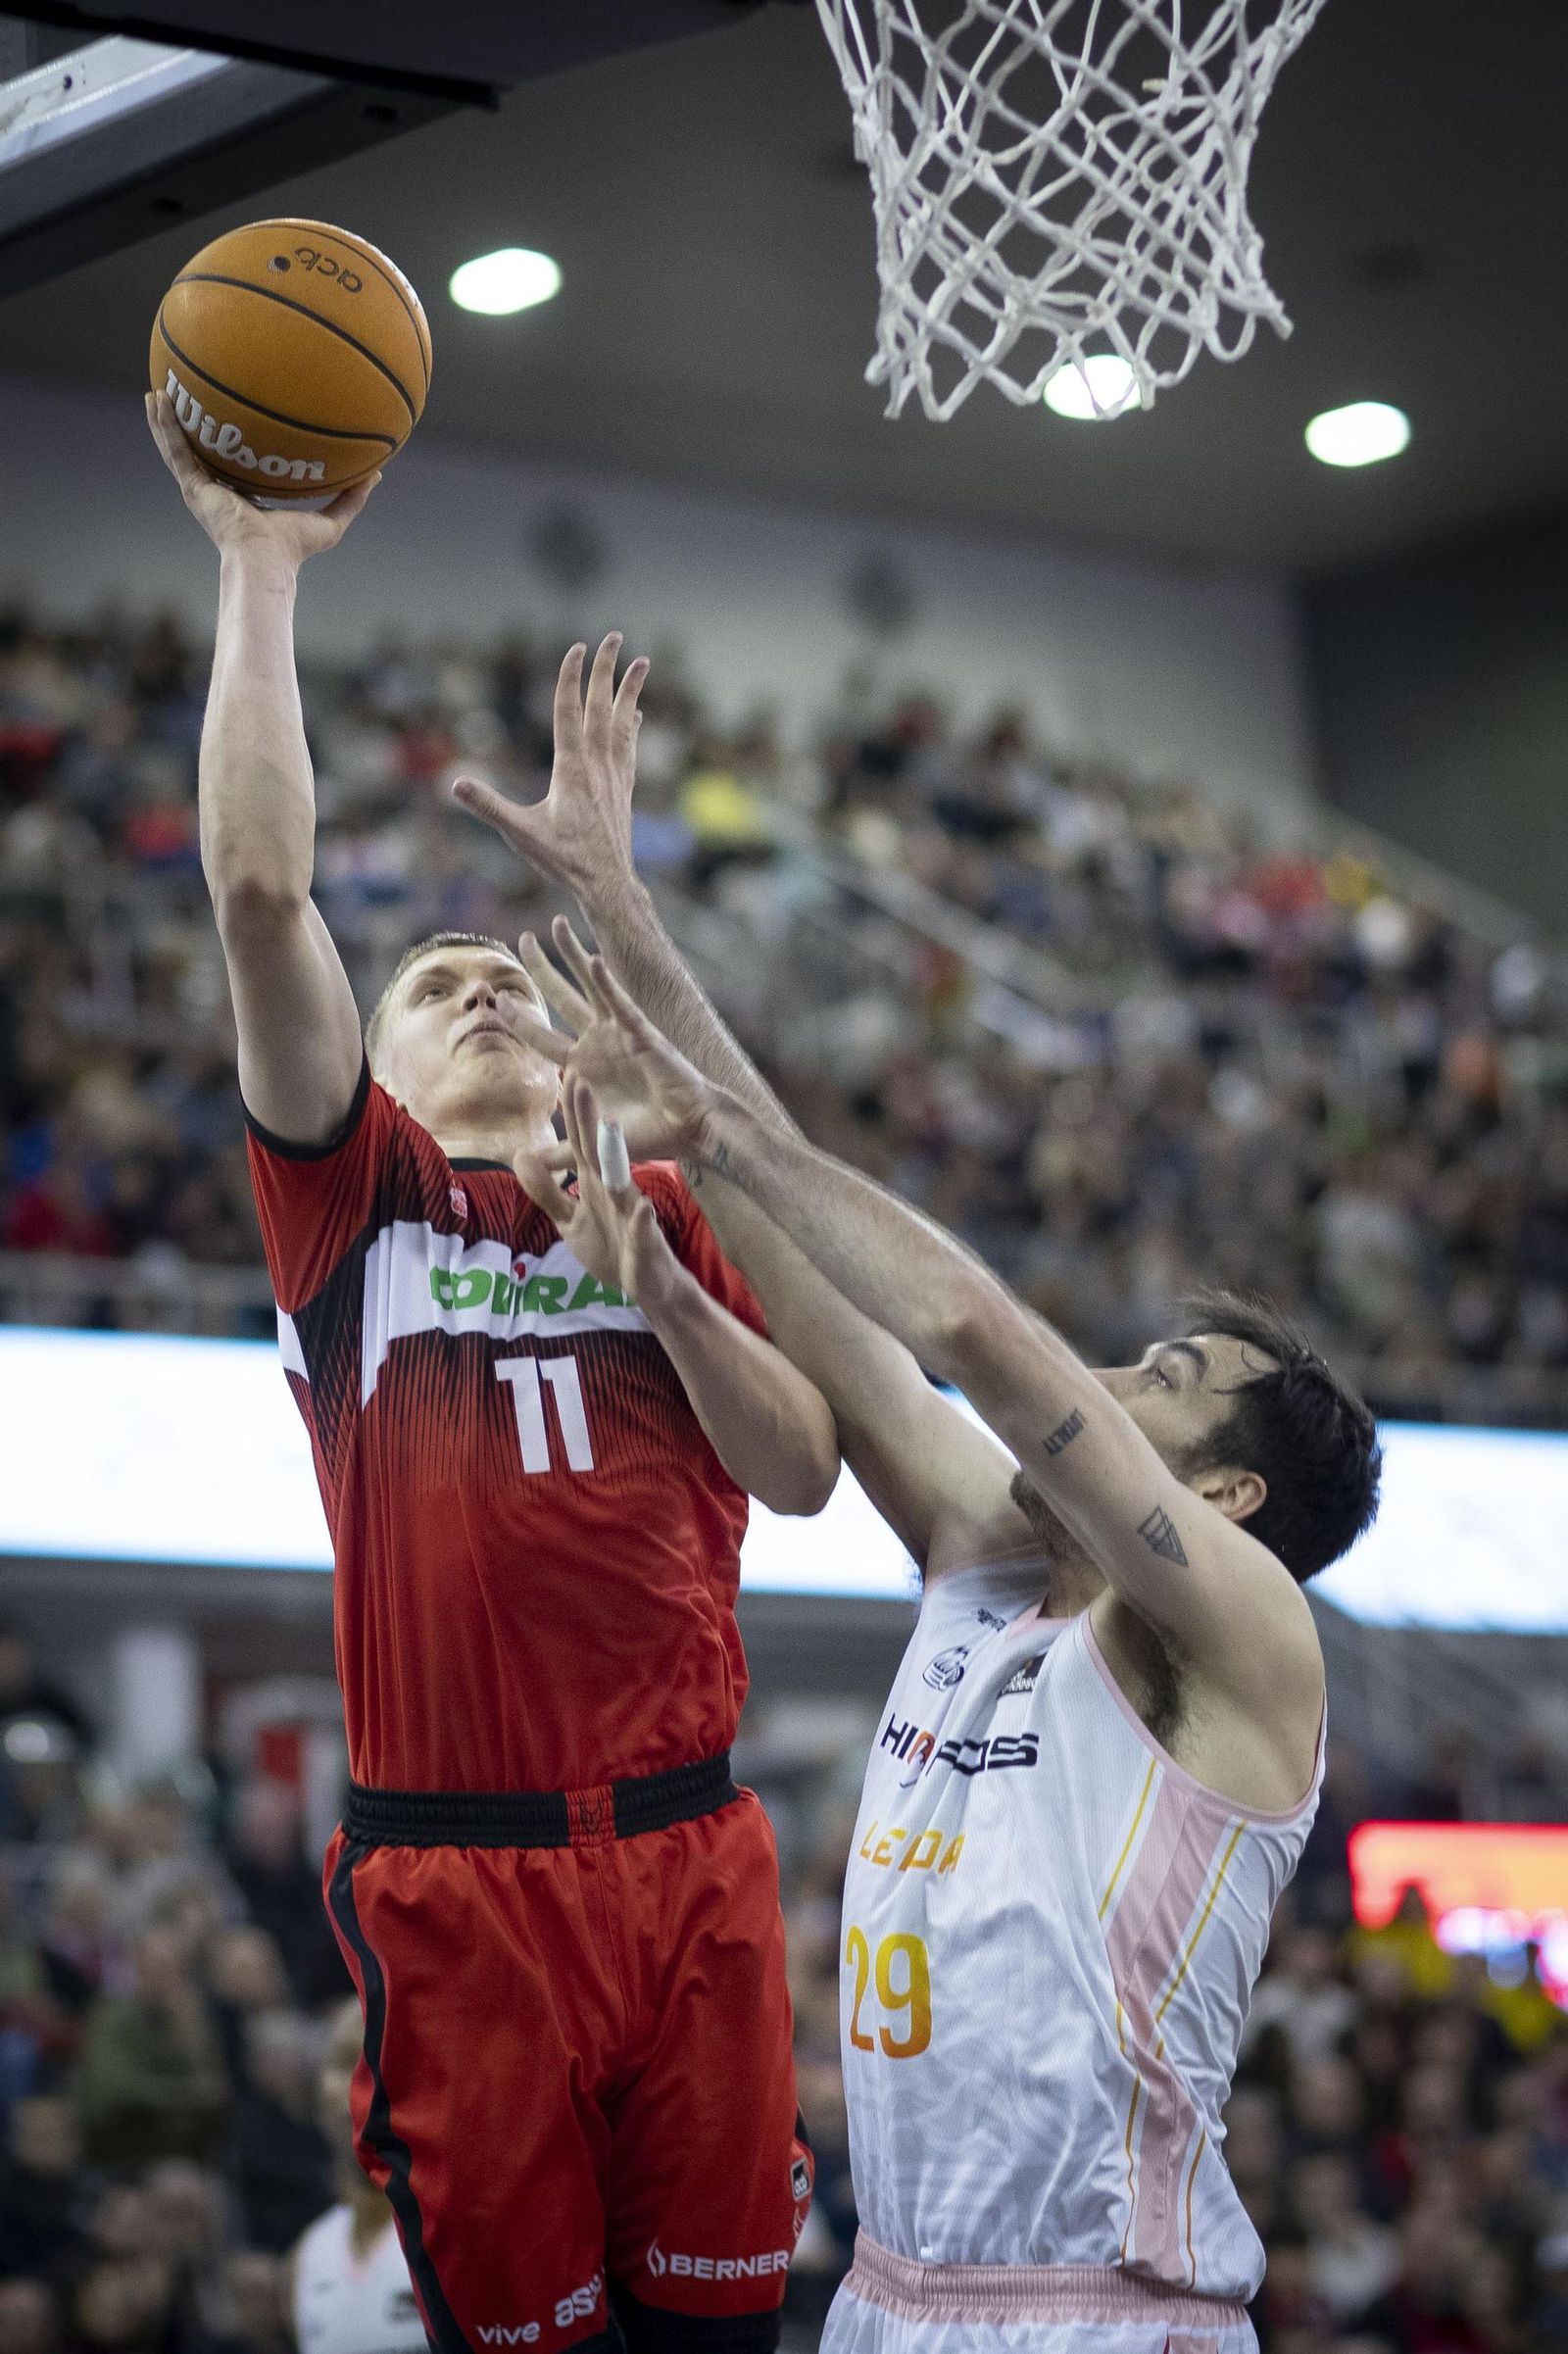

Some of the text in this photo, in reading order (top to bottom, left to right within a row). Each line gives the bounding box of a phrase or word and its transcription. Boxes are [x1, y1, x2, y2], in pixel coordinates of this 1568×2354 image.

[294, 247, 364, 293] acb
[165, 368, 326, 481] Wilson
[494, 1354, 595, 1474] 11
[846, 1926, 933, 2059] 29
[669, 2249, 790, 2280] BERNER
[476, 2321, 540, 2346] vive
